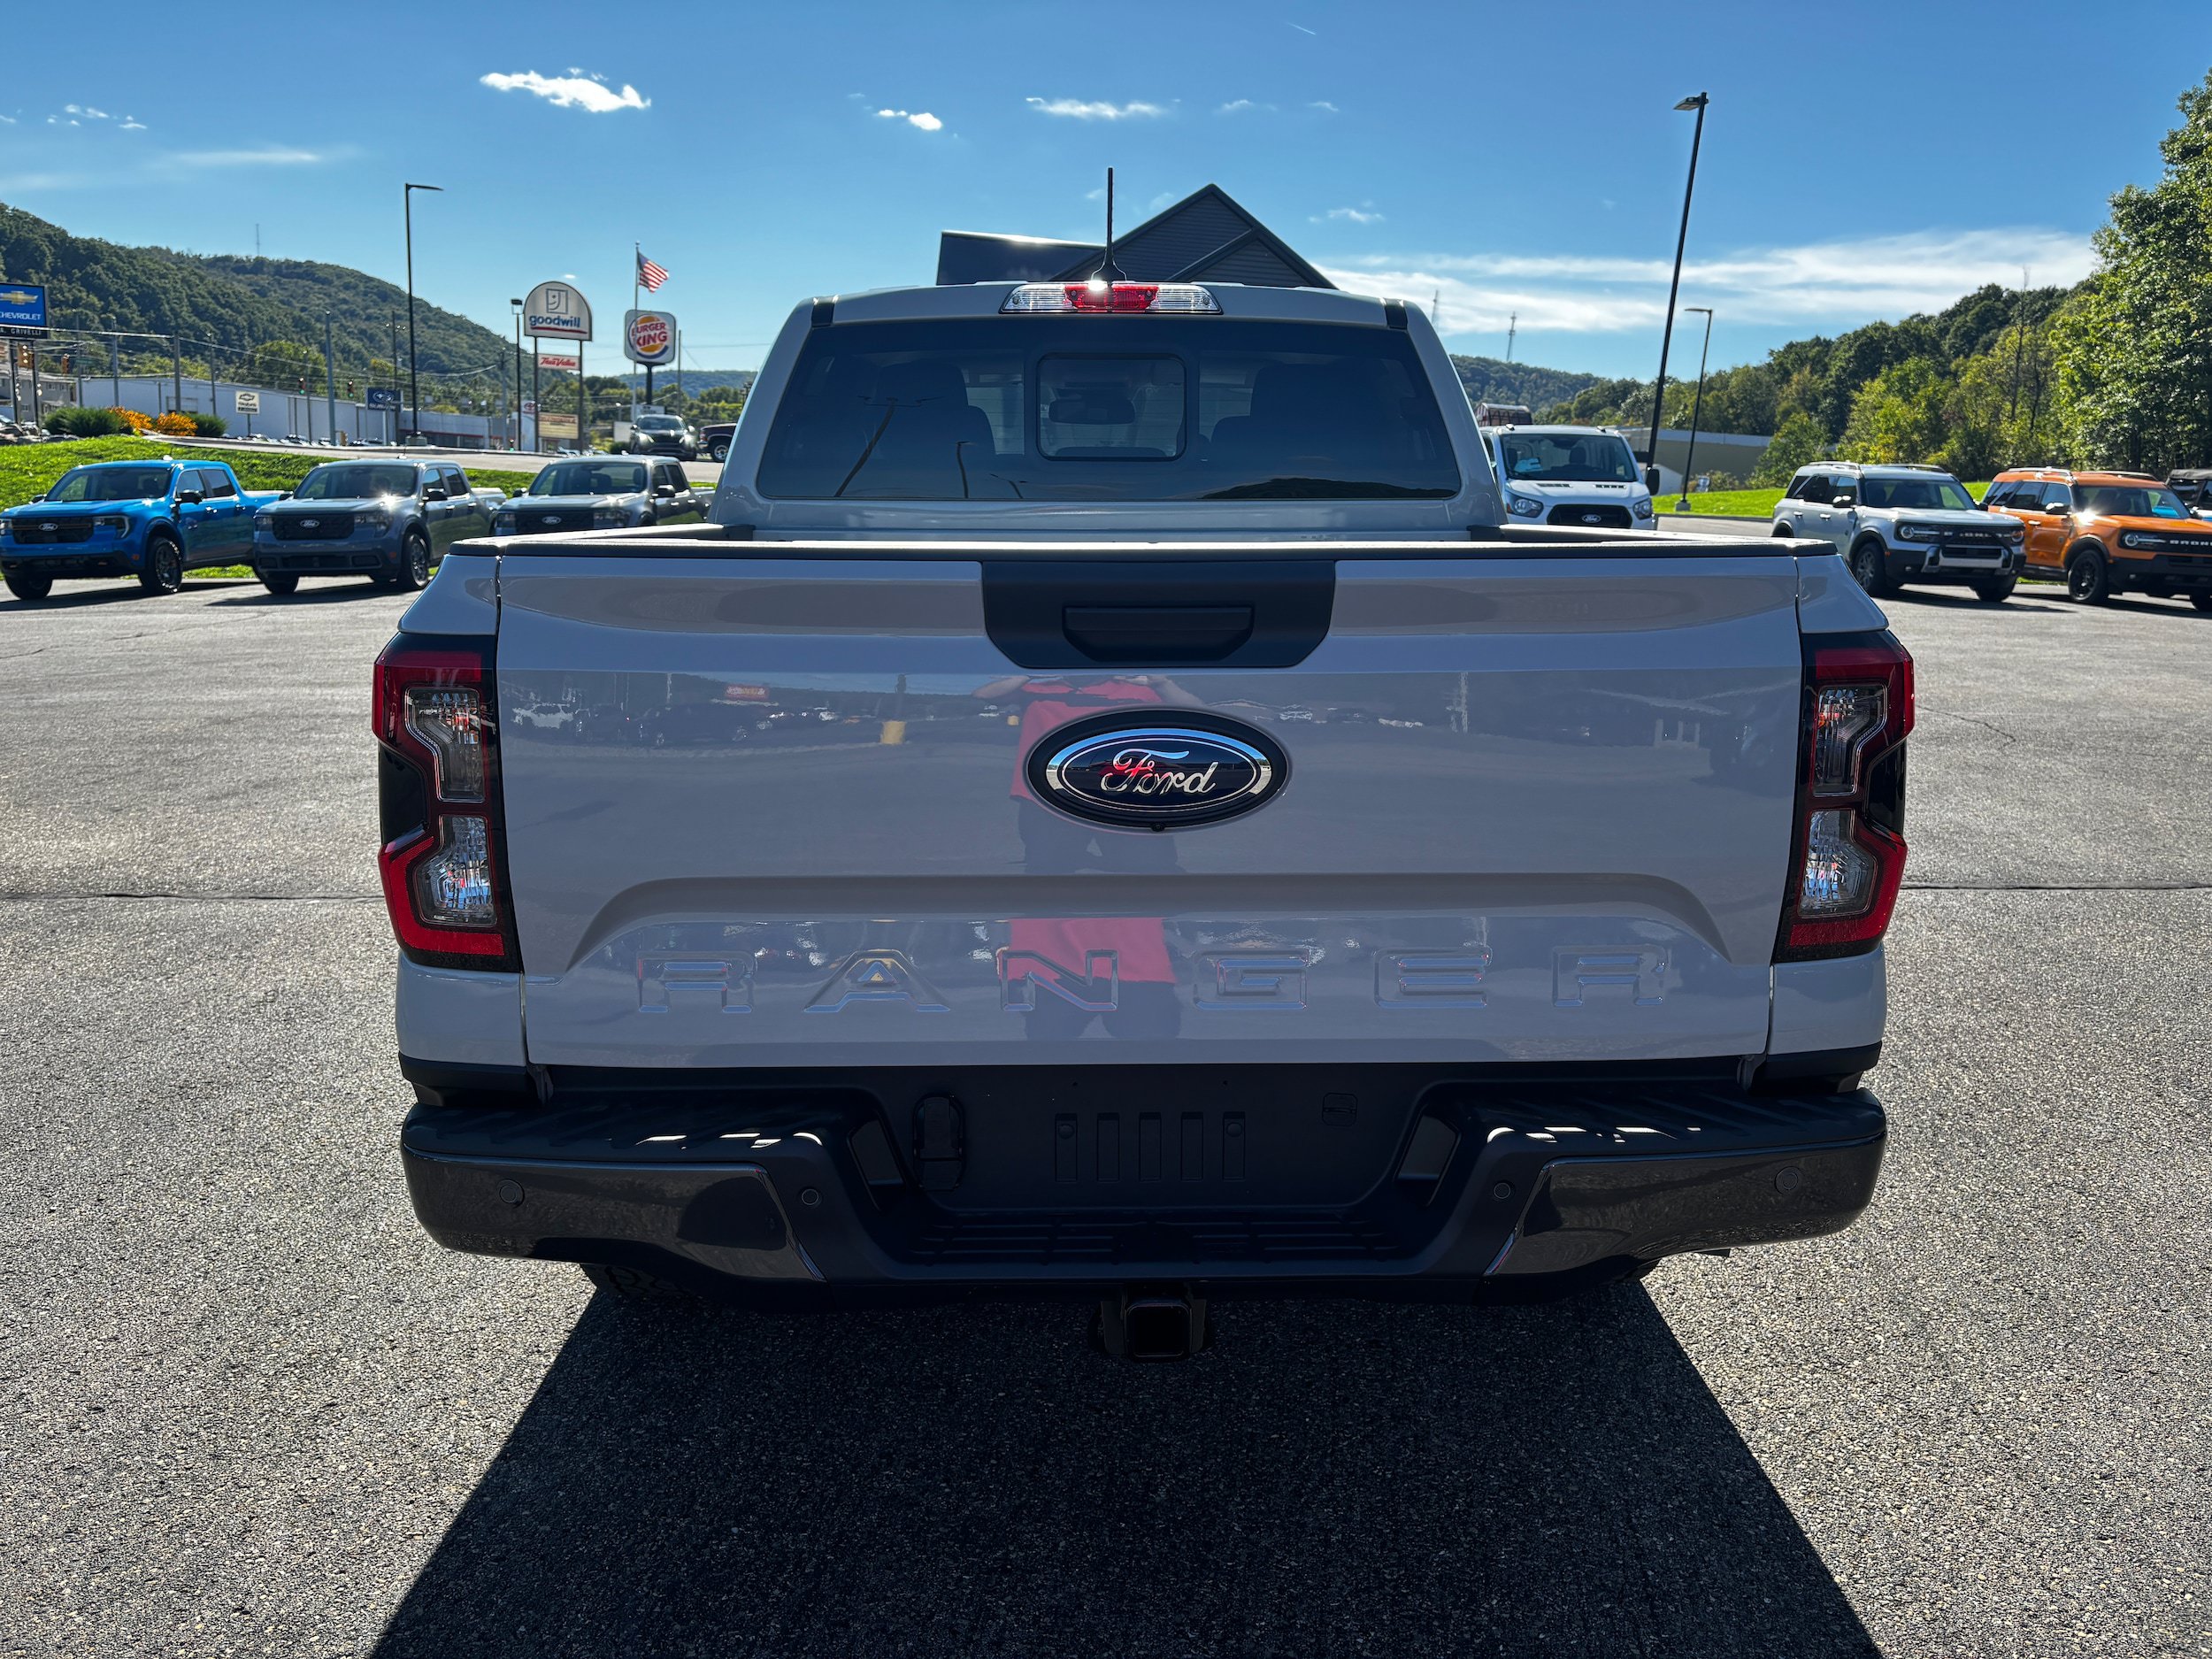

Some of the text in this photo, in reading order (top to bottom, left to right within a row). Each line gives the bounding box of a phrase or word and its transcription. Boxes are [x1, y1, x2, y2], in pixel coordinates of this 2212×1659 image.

[529, 315, 580, 327] goodwill
[634, 330, 667, 347] KING
[1100, 749, 1219, 795] Ford
[636, 943, 1670, 1013] RANGER
